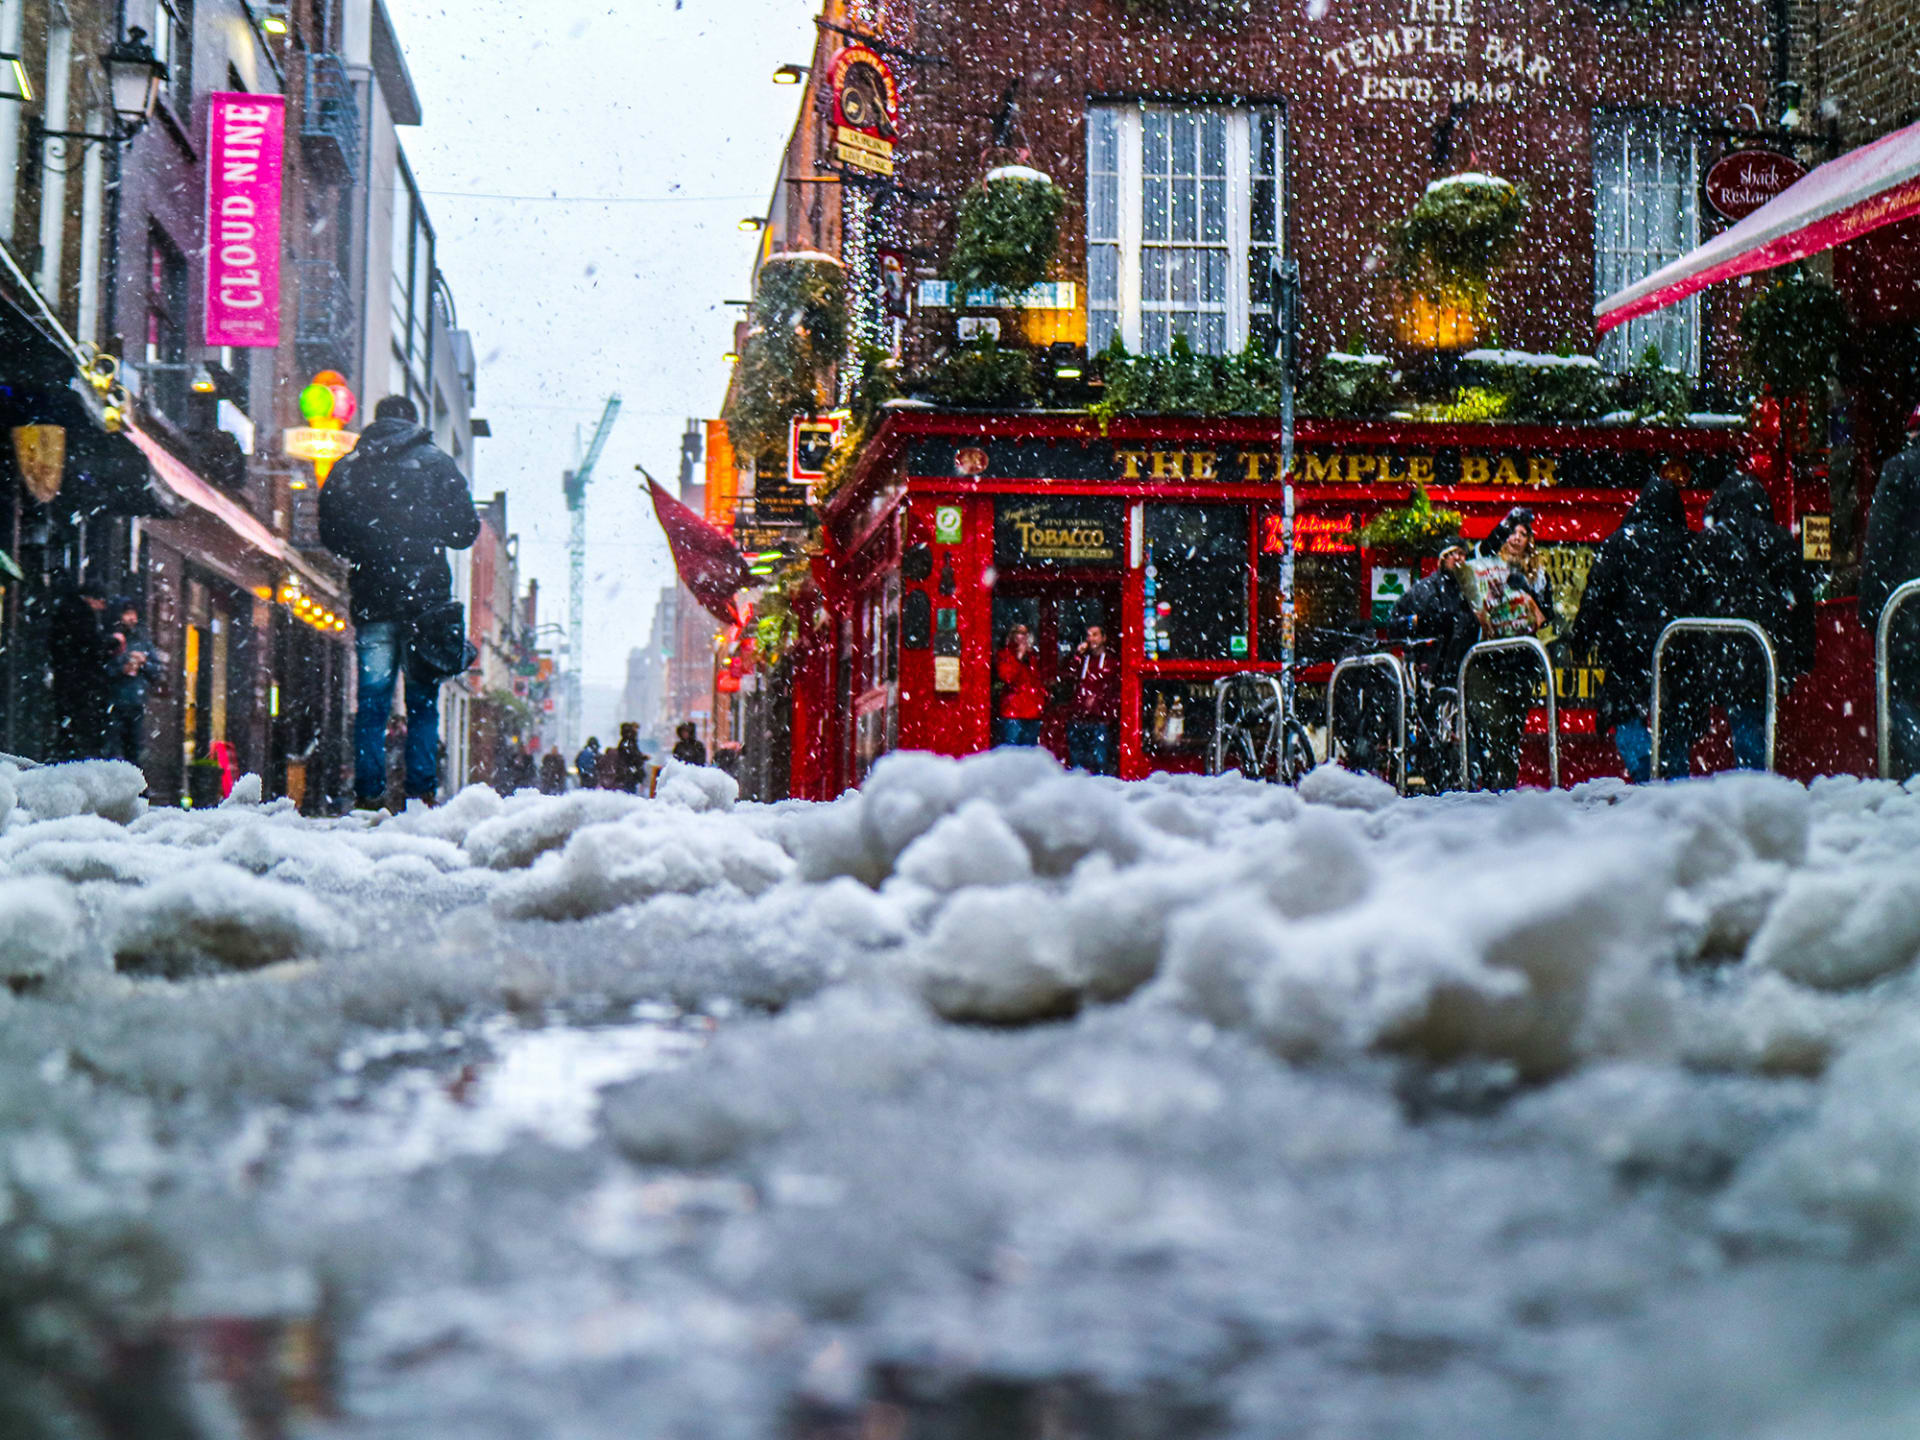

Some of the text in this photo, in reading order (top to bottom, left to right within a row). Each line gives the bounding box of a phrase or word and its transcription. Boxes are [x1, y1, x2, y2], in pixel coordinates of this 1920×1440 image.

[1408, 0, 1474, 23] THE
[1323, 25, 1551, 86] TEMPLE BAR
[222, 103, 270, 183] NINE
[219, 195, 264, 309] CLOUD
[1113, 451, 1558, 484] THE TEMPLE BAR
[1016, 522, 1105, 552] TOBACCO
